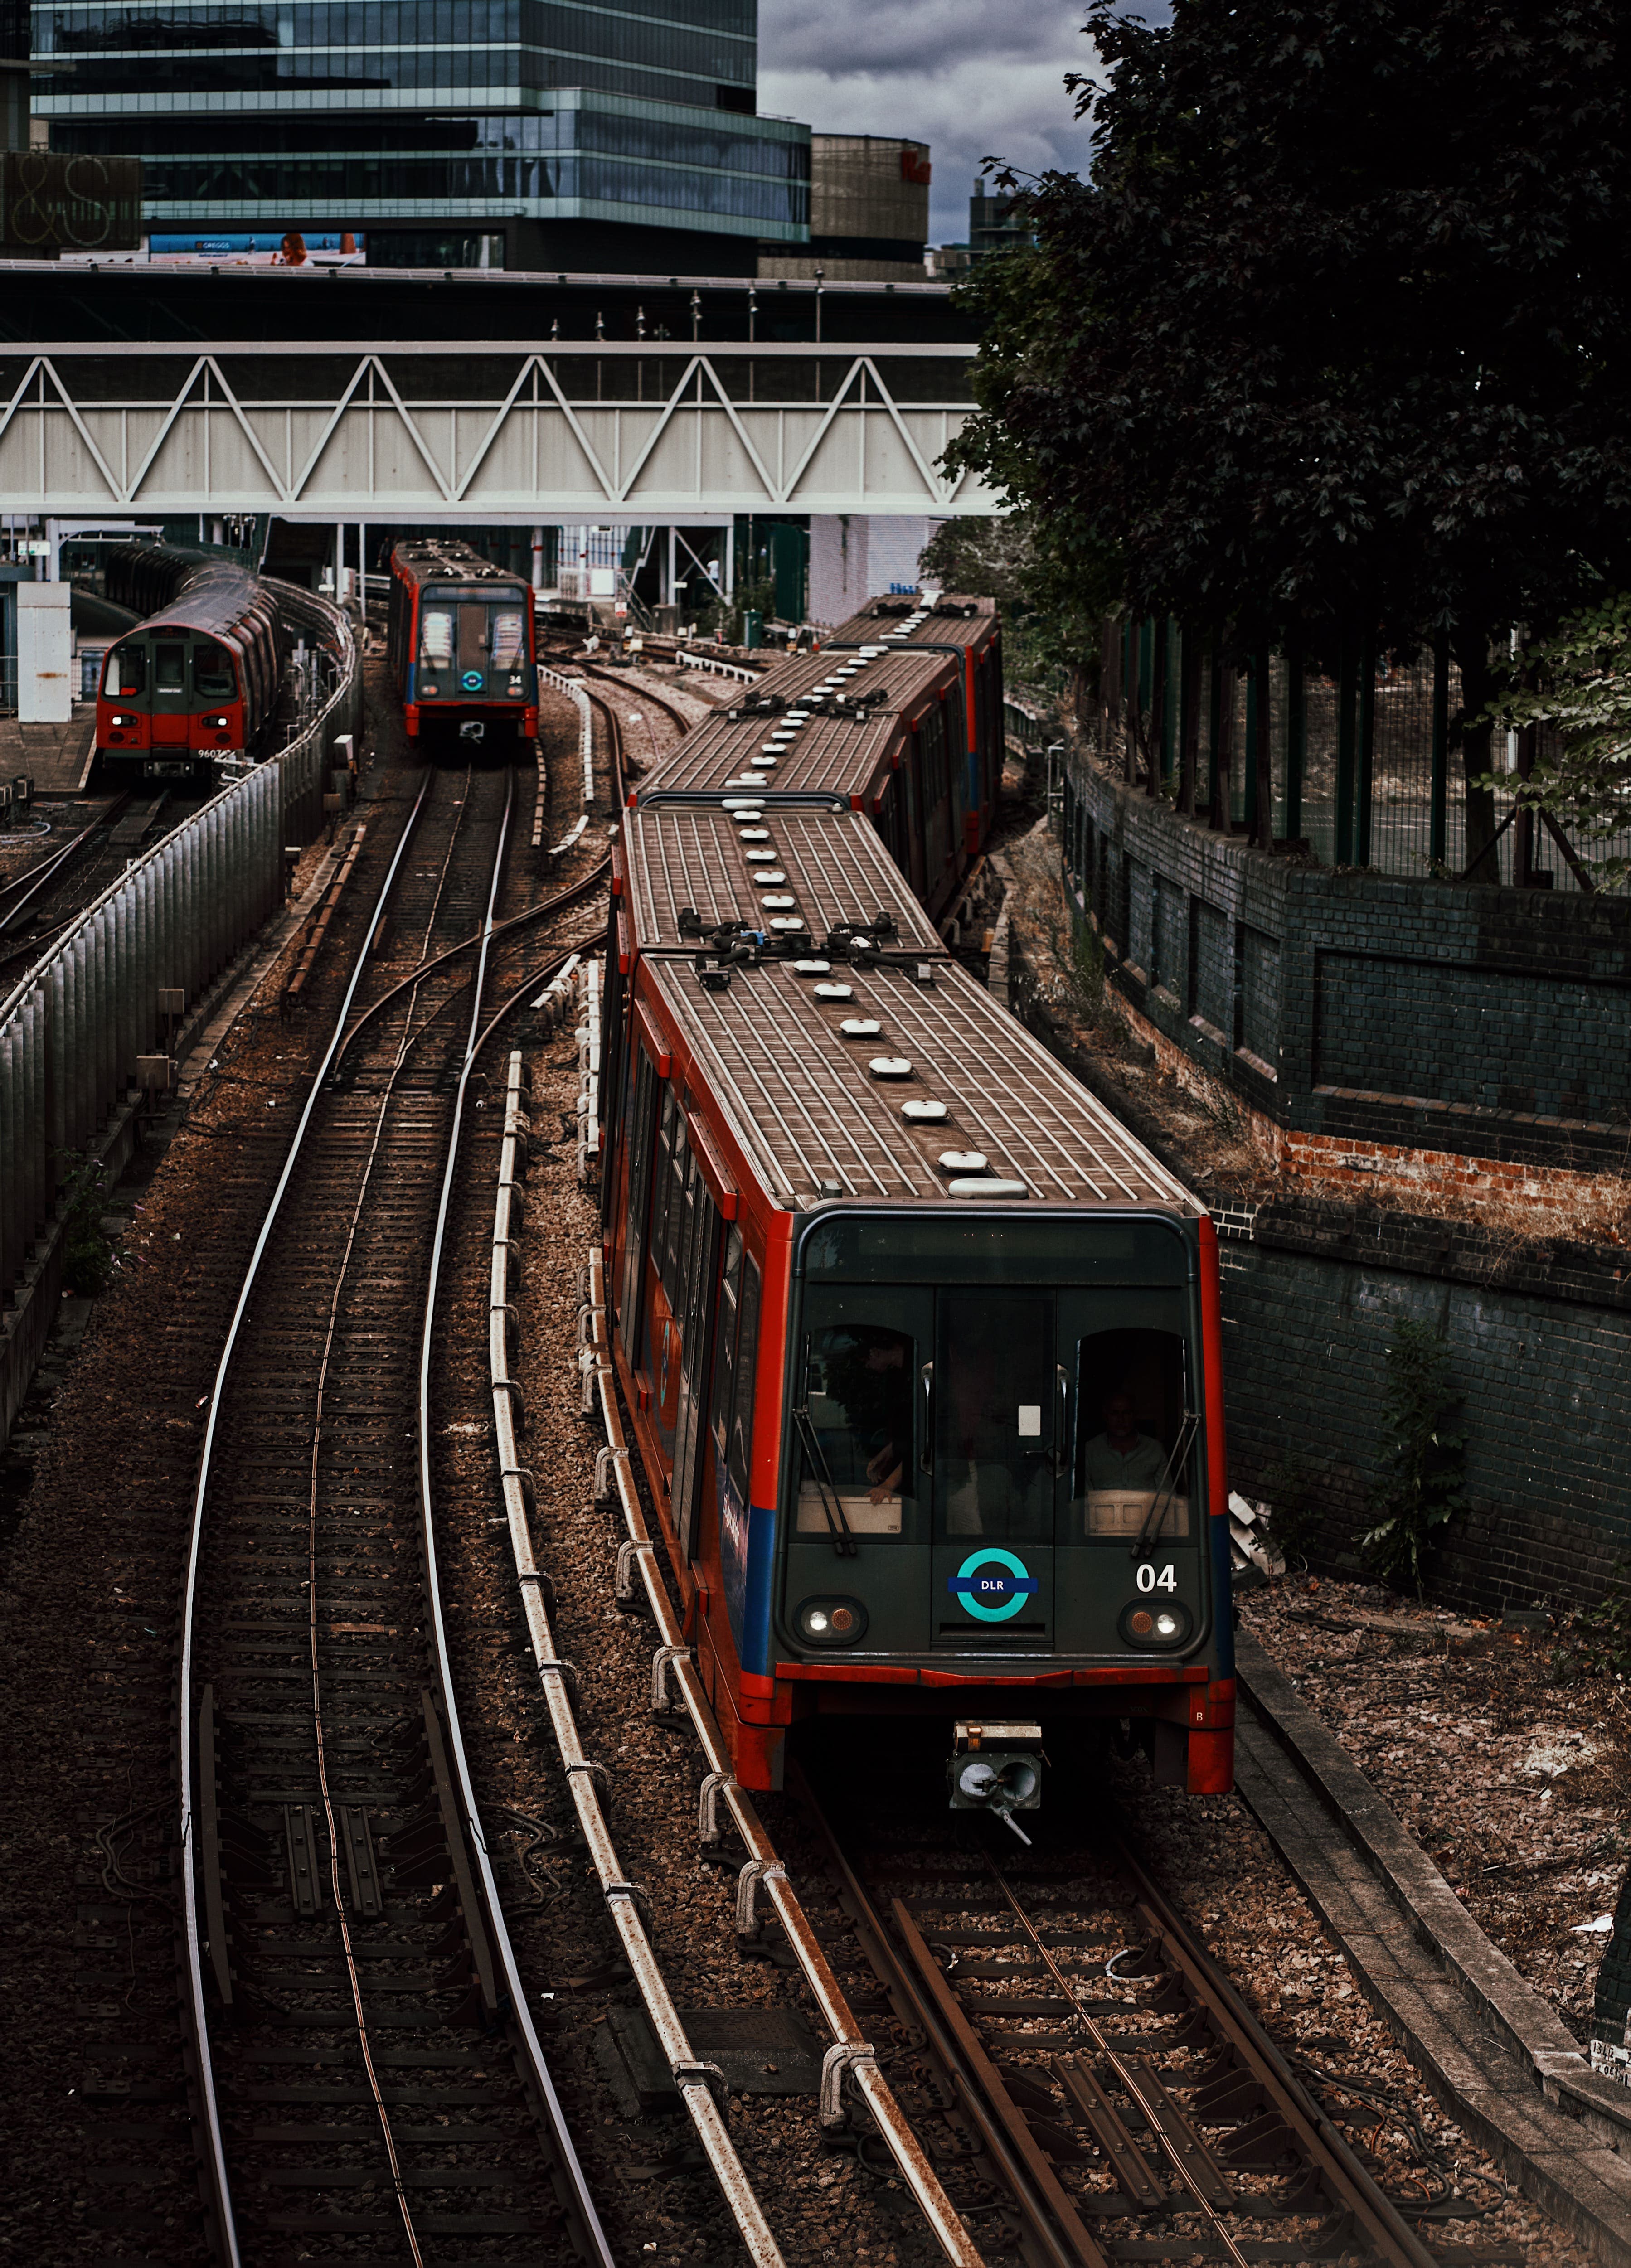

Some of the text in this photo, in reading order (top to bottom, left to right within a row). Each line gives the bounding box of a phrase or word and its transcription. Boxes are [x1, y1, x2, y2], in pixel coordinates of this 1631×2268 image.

[509, 675, 521, 684] 34
[1136, 1564, 1177, 1592] 04
[981, 1581, 1004, 1590] DLR
[1196, 1712, 1203, 1721] B
